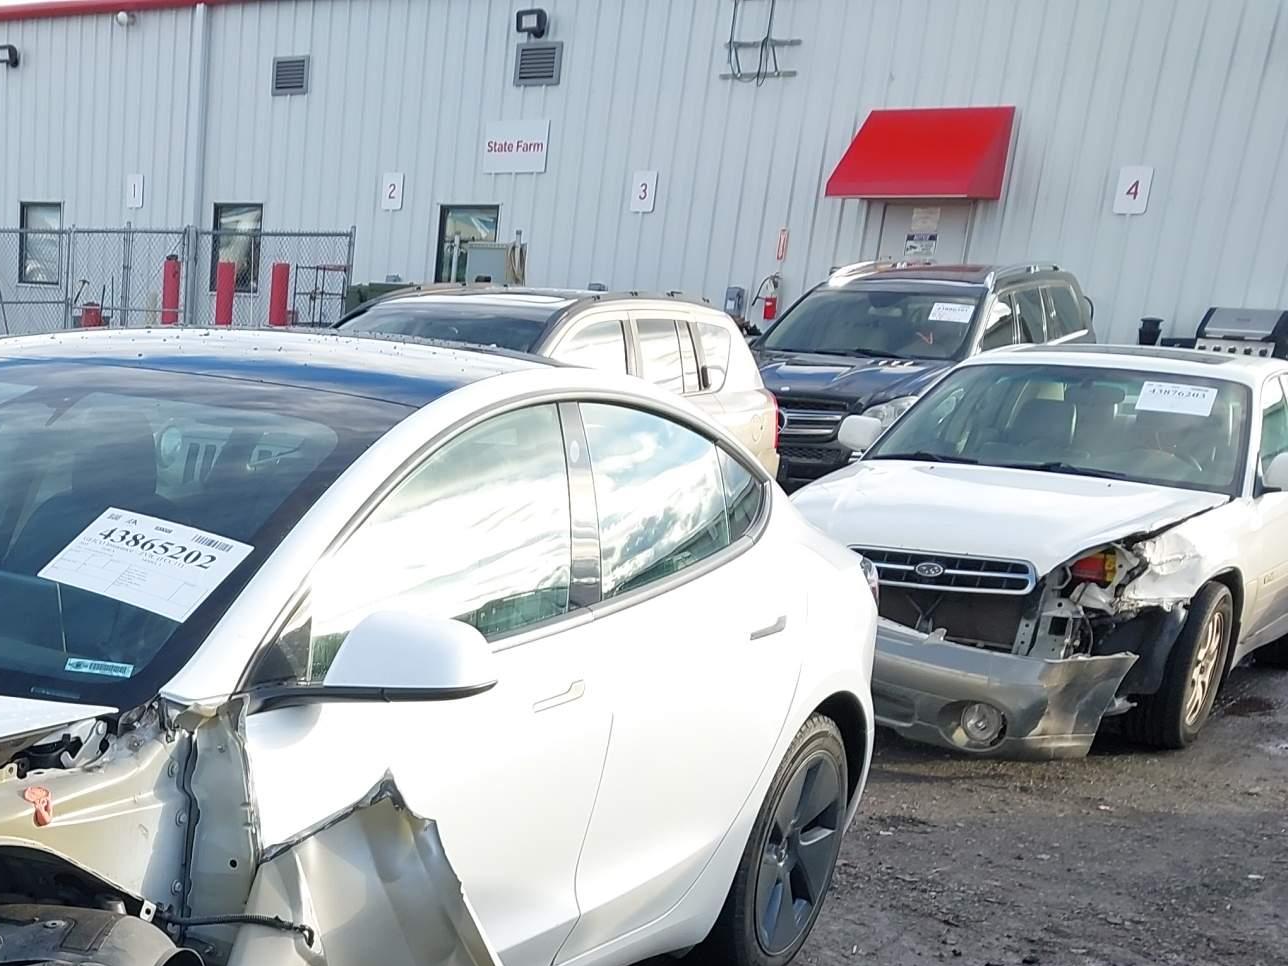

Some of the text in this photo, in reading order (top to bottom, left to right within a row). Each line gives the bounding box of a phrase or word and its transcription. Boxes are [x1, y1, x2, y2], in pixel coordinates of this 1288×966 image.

[487, 140, 544, 153] State Farm
[388, 183, 397, 200] 2
[638, 182, 648, 201] 3
[1125, 179, 1140, 201] 4
[98, 526, 218, 570] 43865202
